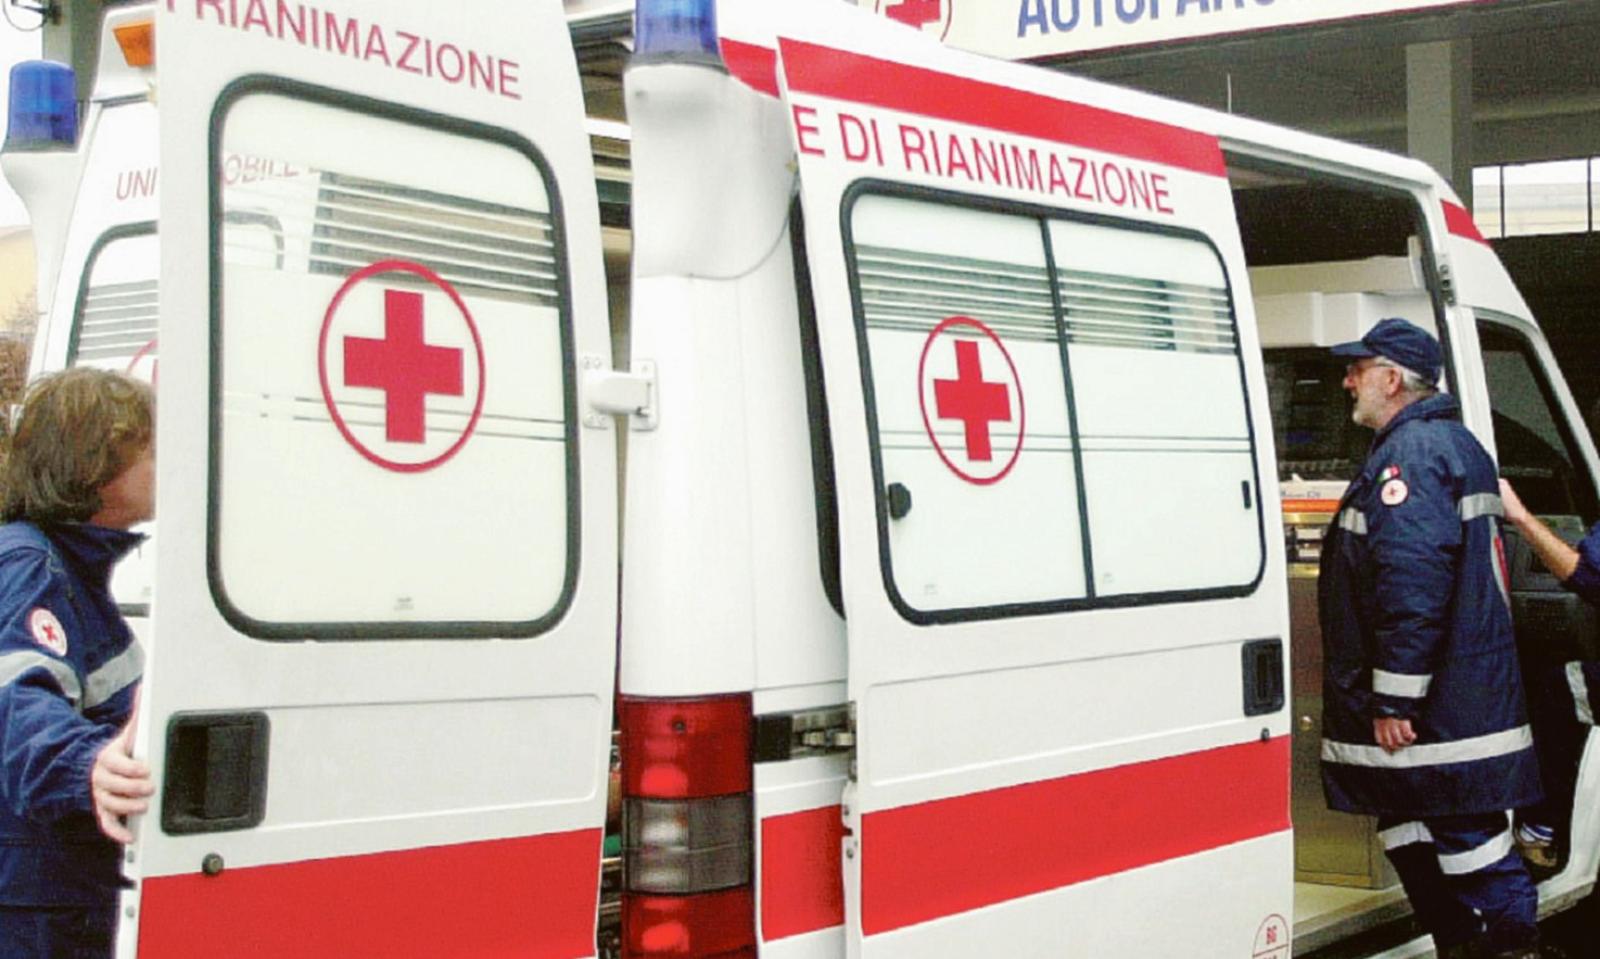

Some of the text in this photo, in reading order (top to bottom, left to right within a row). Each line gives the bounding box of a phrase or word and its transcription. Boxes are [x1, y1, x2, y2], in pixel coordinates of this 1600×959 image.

[791, 104, 1174, 215] E DI RIANIMAZIONE
